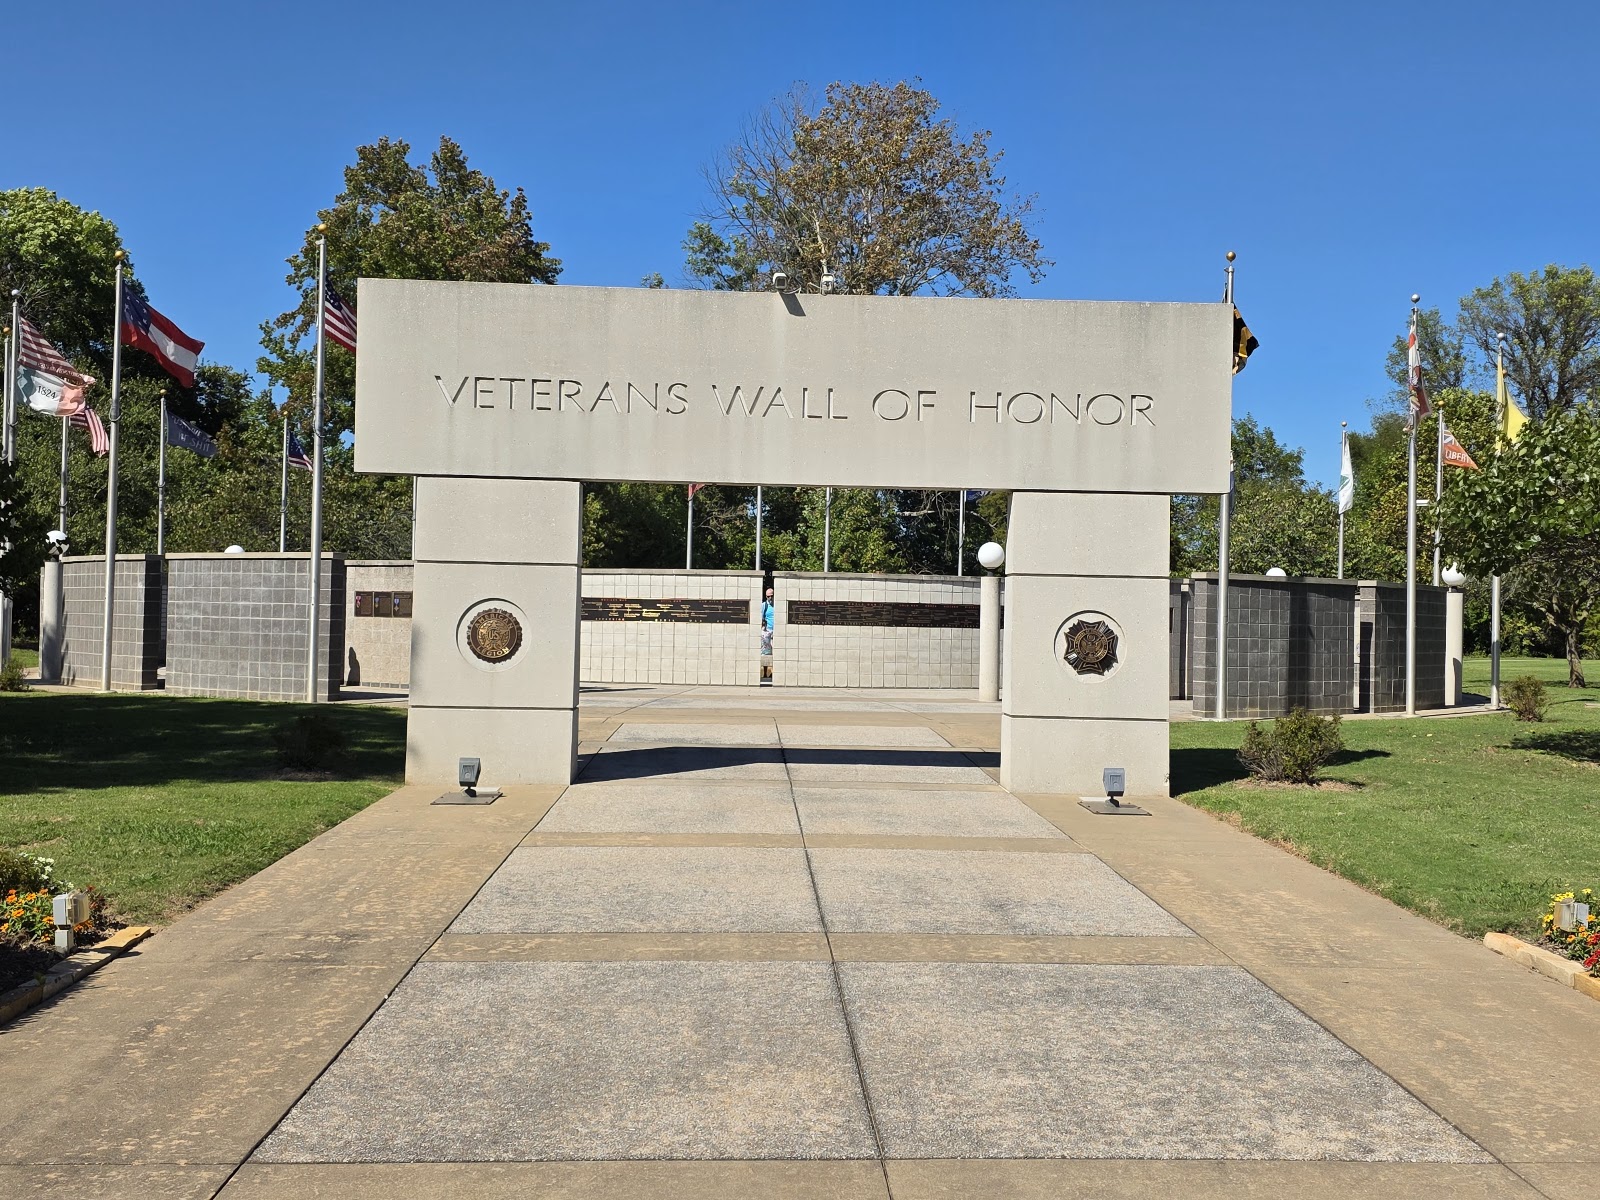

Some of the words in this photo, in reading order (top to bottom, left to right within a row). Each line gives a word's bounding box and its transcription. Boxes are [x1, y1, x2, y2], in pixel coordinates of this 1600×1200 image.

[37, 385, 58, 399] 1824
[434, 375, 689, 415] VETERANS
[711, 384, 848, 420] WALL
[872, 388, 937, 422] OF
[969, 391, 1156, 426] HONOR
[475, 613, 514, 629] AMERICAN
[477, 646, 510, 657] LEGION
